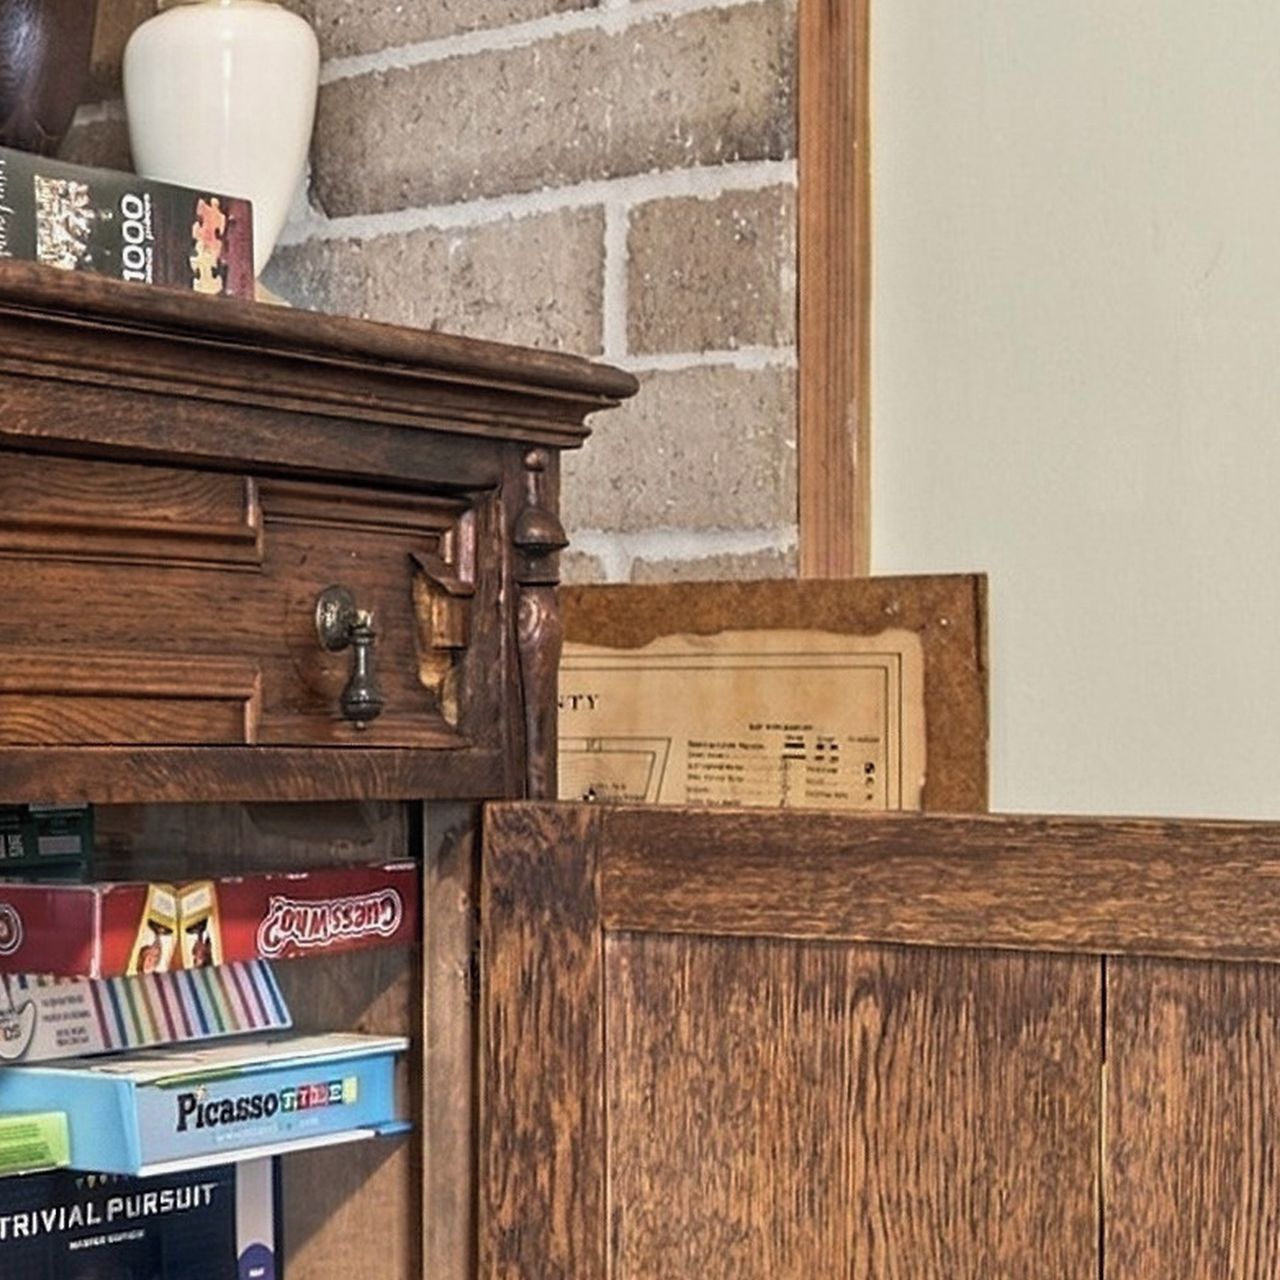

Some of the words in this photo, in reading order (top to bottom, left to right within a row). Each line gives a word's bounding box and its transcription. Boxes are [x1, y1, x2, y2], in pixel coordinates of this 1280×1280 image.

[122, 193, 145, 282] 1000
[258, 896, 333, 957] Who?
[331, 889, 401, 938] Guess
[106, 1182, 218, 1223] PURSUIT
